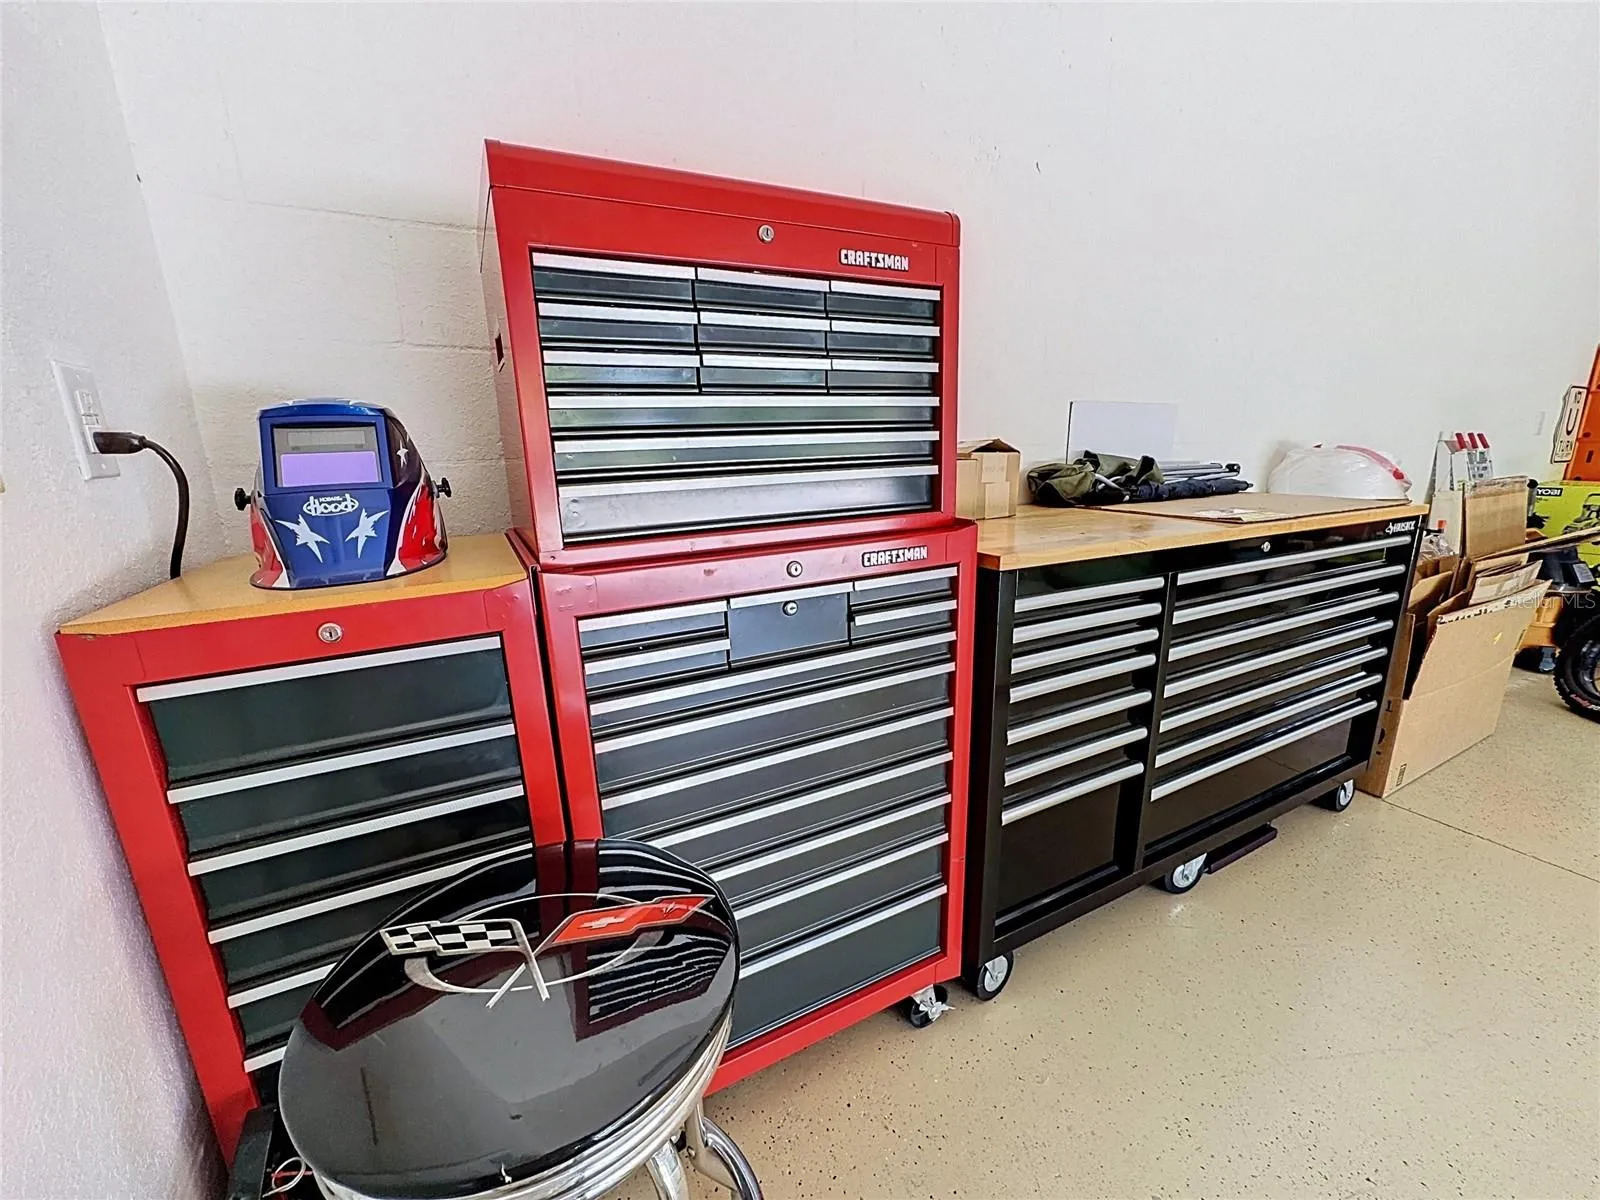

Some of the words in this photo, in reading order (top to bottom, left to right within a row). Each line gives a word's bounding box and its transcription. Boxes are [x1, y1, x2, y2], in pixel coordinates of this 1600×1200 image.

[840, 249, 909, 271] CRAFTSMAN
[1536, 488, 1561, 496] YOBI
[863, 546, 928, 567] CRAFTSMAN
